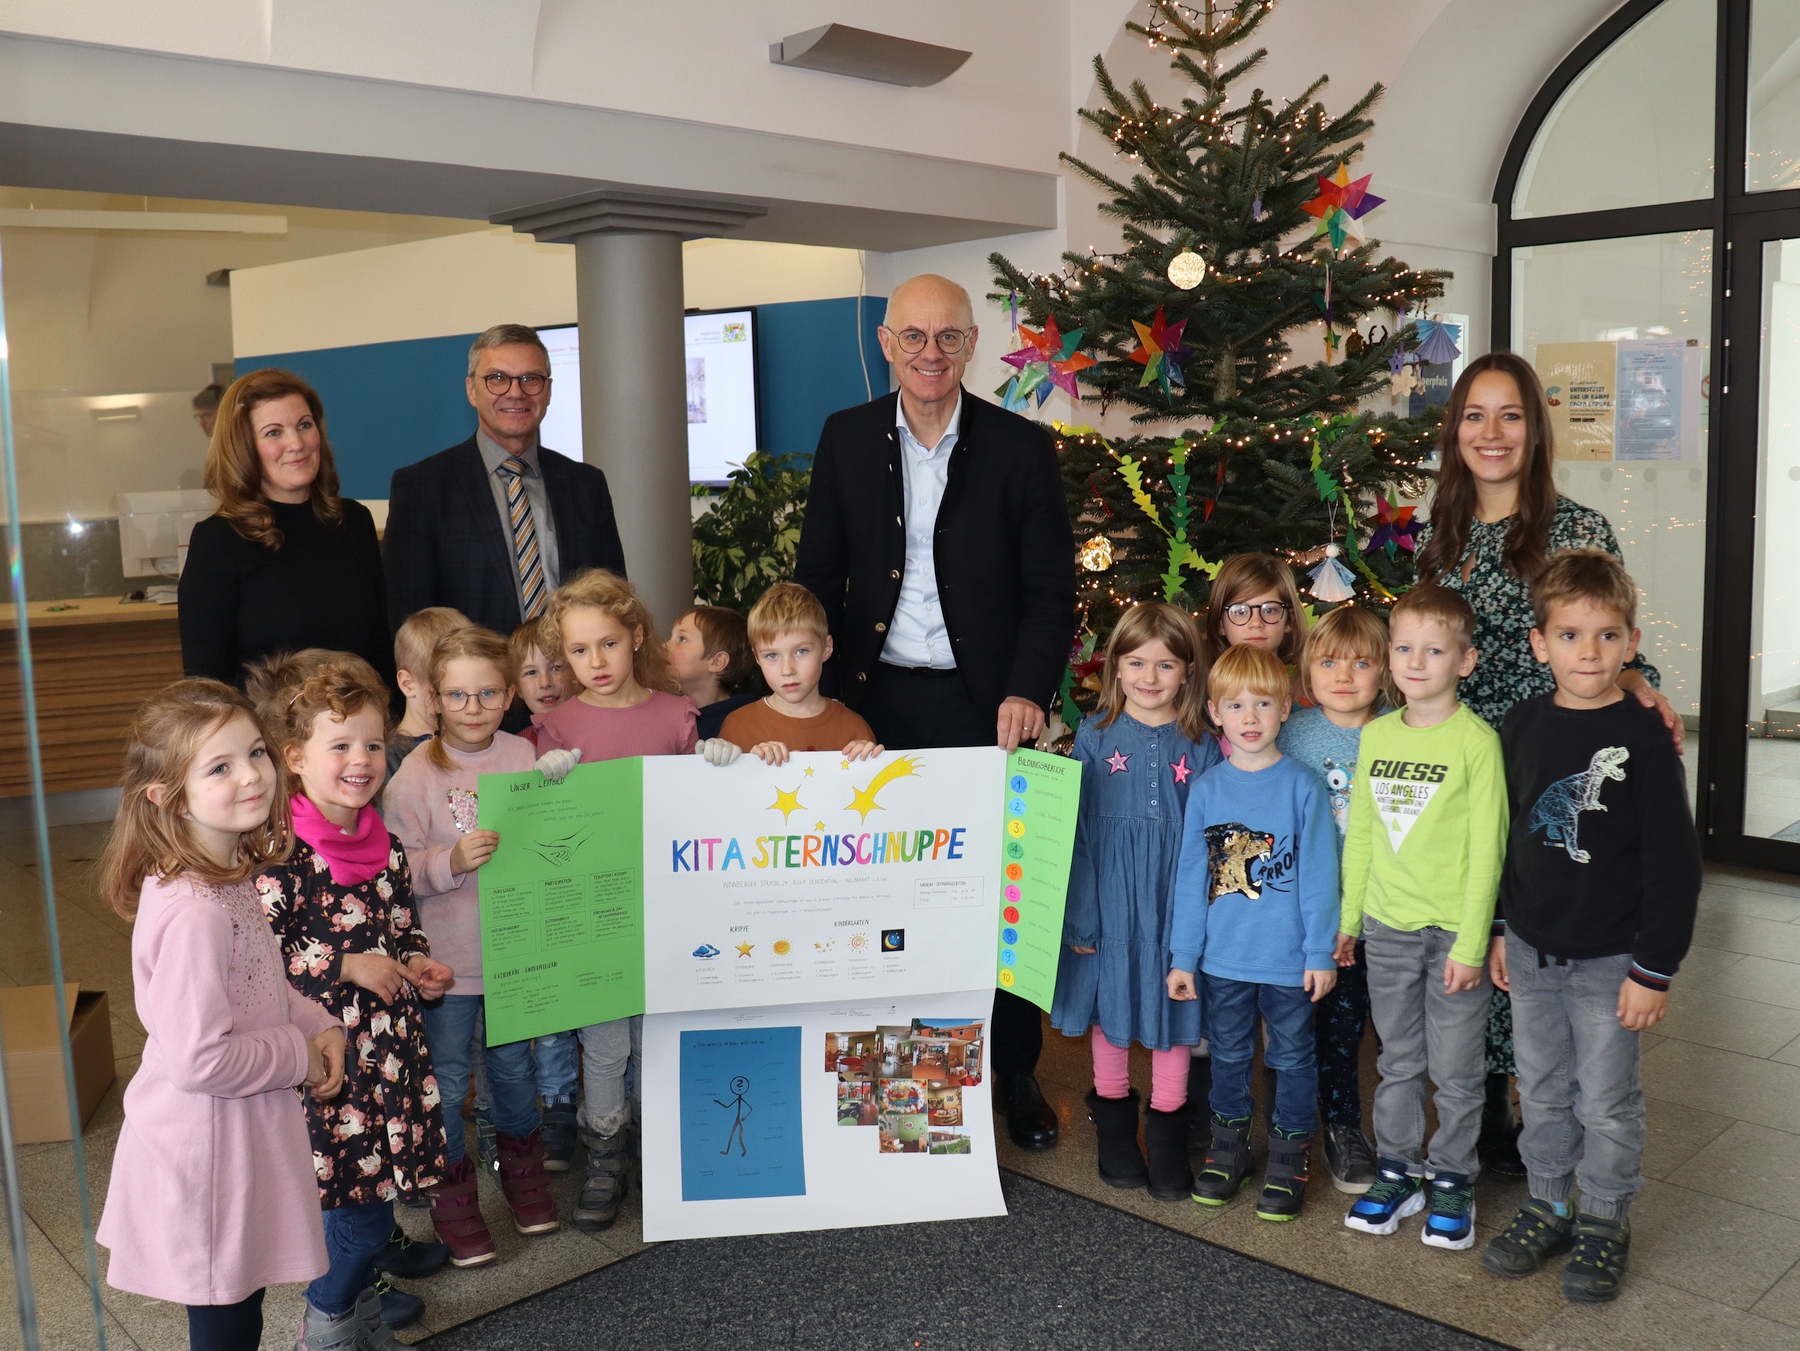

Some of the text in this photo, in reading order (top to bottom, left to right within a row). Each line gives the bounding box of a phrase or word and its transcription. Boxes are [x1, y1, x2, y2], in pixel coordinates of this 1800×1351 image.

[1369, 759, 1449, 784] GUESS
[510, 782, 531, 792] UNSER
[1016, 780, 1021, 790] 1
[1375, 782, 1430, 800] LOS ANGELES
[1014, 802, 1020, 812] 2
[1014, 822, 1020, 834] 3
[671, 828, 967, 873] KITA STERNSCHNUPPE
[1012, 844, 1018, 855] 4
[1012, 866, 1018, 876] 5
[1010, 888, 1016, 898] 6
[1010, 910, 1014, 920] 7
[833, 919, 870, 927] KINDERGARTEN
[730, 925, 750, 933] KRIPPE
[1006, 951, 1012, 964] 9
[1003, 973, 1010, 982] 10
